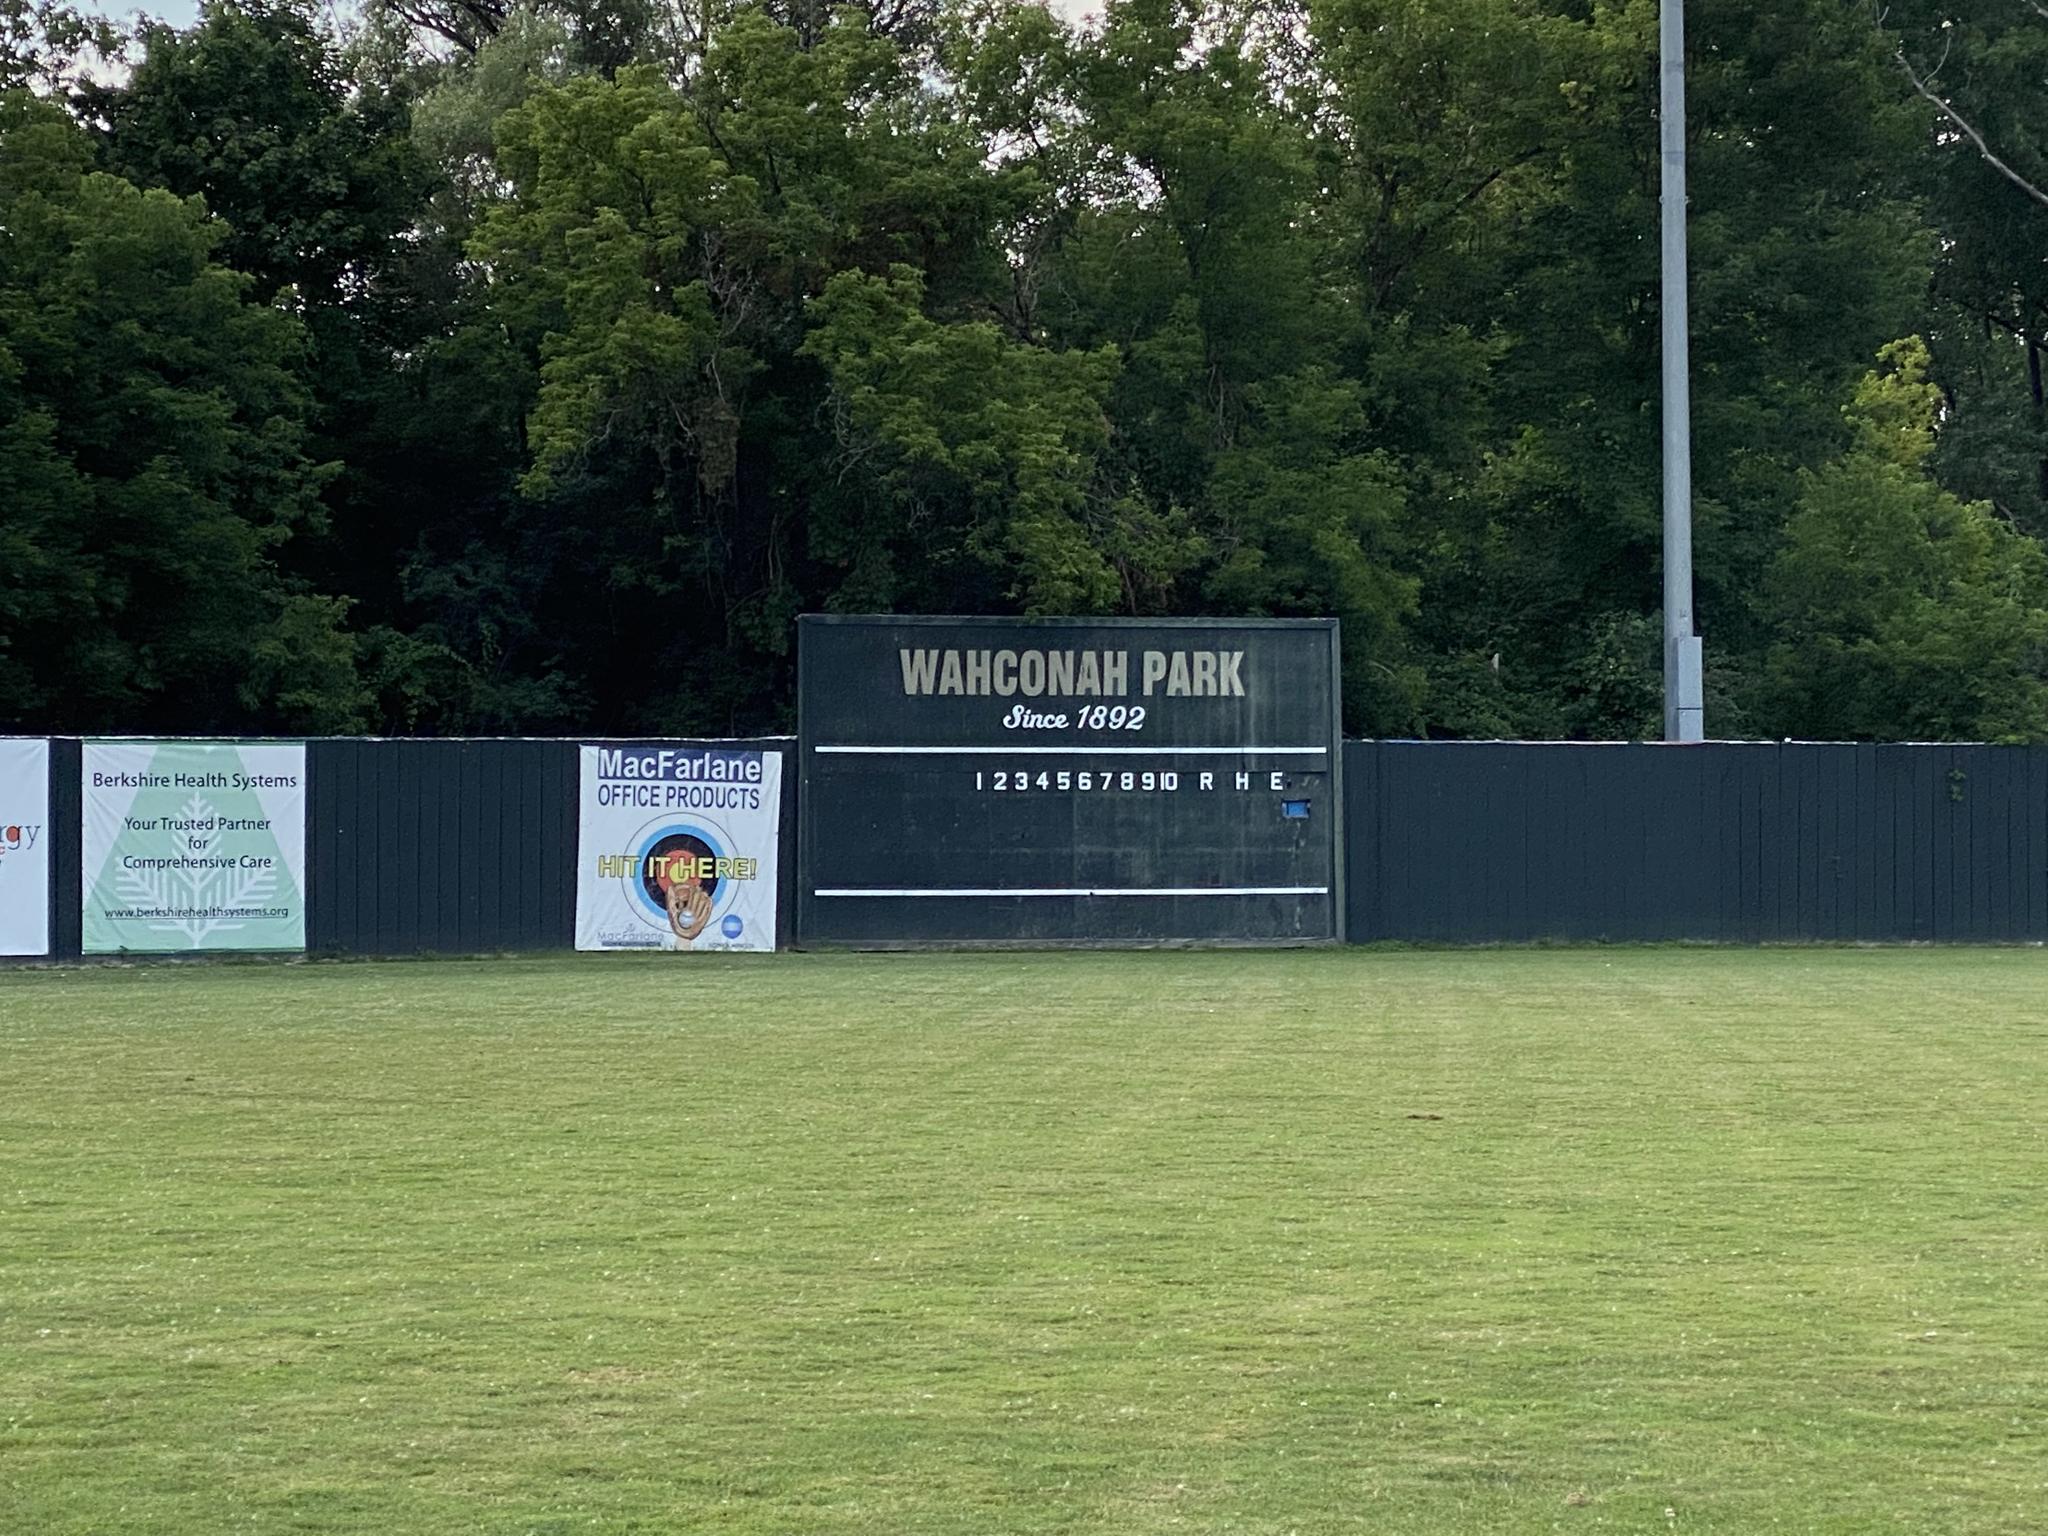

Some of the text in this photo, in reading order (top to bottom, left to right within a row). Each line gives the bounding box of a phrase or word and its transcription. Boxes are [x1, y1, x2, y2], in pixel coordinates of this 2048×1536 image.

[900, 648, 1246, 697] WAHCONAH PARK
[1002, 704, 1147, 731] Since 1892
[600, 749, 761, 782] MacFarlane
[93, 773, 297, 791] Berkshire Health Systems
[993, 772, 1007, 791] 2
[1014, 772, 1028, 791] 3
[1036, 772, 1049, 791] 4
[1057, 772, 1071, 791] 5
[1078, 772, 1092, 791] 6
[1100, 772, 1113, 791] 7
[1120, 772, 1134, 791] 8
[1200, 772, 1213, 791] R
[1235, 772, 1249, 791] H
[1270, 771, 1284, 790] E
[598, 784, 760, 809] OFFICE PRODUCTS
[124, 817, 271, 830] Your Trusted Partner
[188, 836, 208, 849] for
[123, 855, 272, 869] Comprehensive Care
[598, 855, 757, 880] HIT IT HERE!
[104, 906, 289, 919] www.berkshirehealthsystems.org
